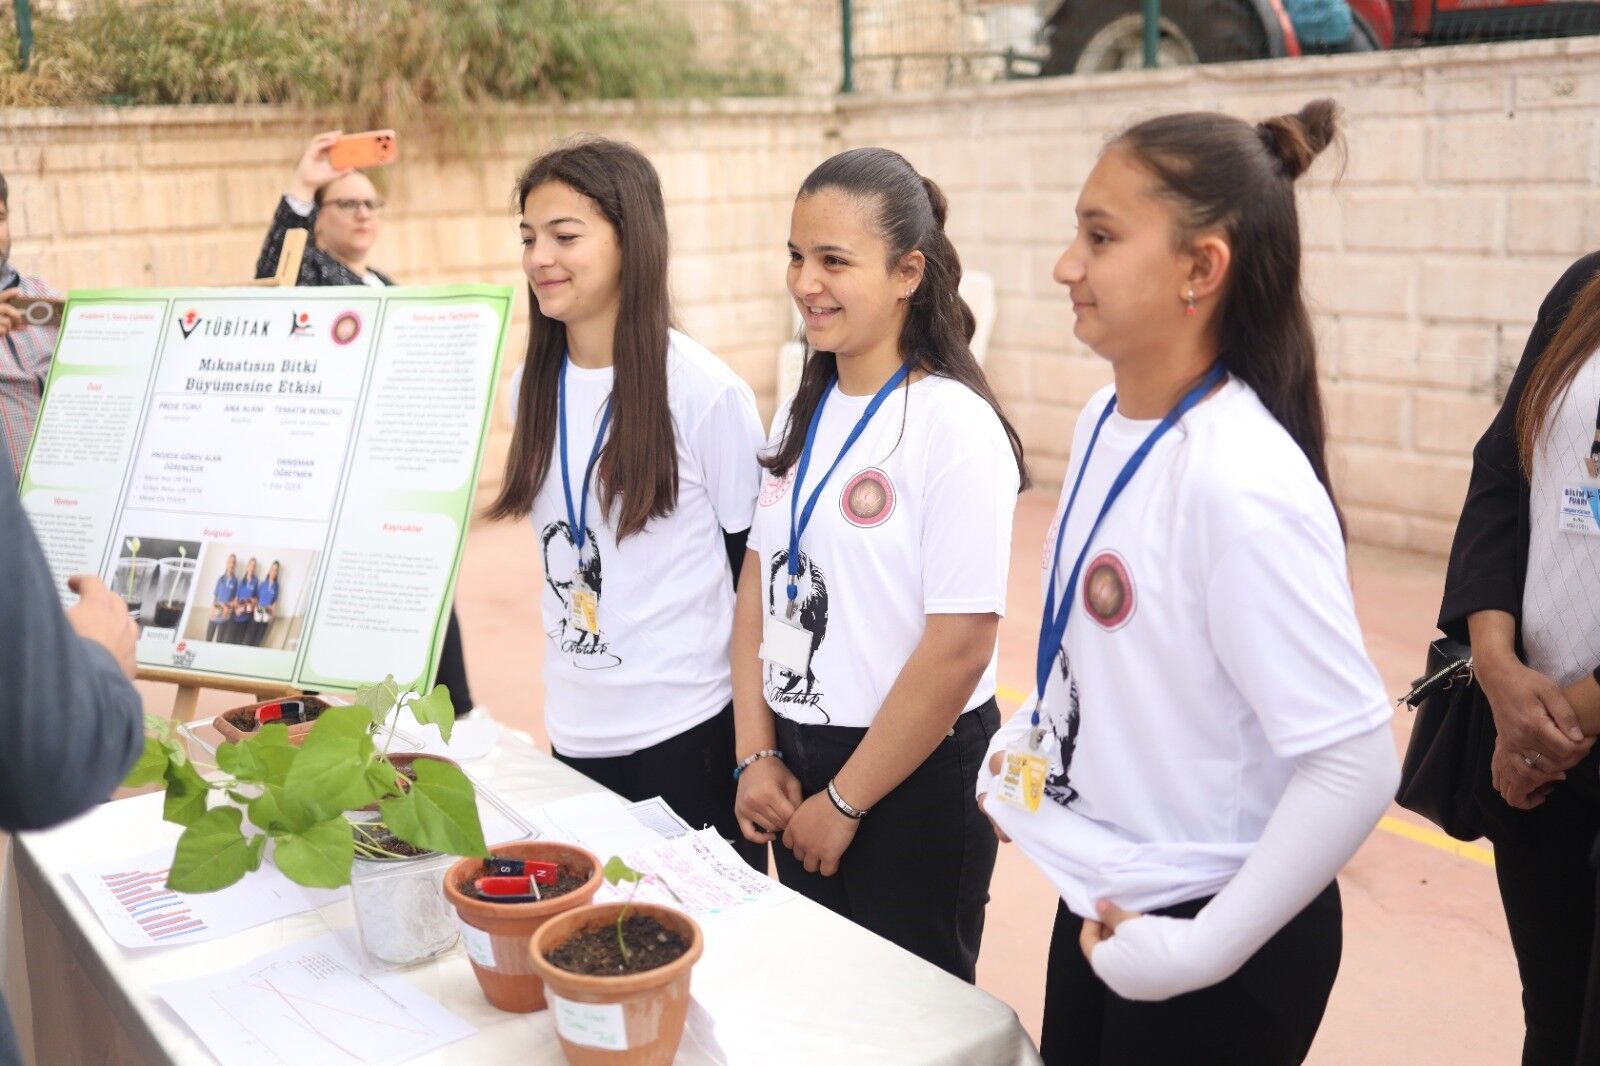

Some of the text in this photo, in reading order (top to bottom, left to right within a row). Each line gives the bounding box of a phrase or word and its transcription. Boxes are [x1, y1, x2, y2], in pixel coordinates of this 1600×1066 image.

[204, 316, 271, 336] TÜBİTAK
[199, 357, 318, 374] Mıknatısın Bitki
[185, 377, 323, 395] Büyümesine Etkisi
